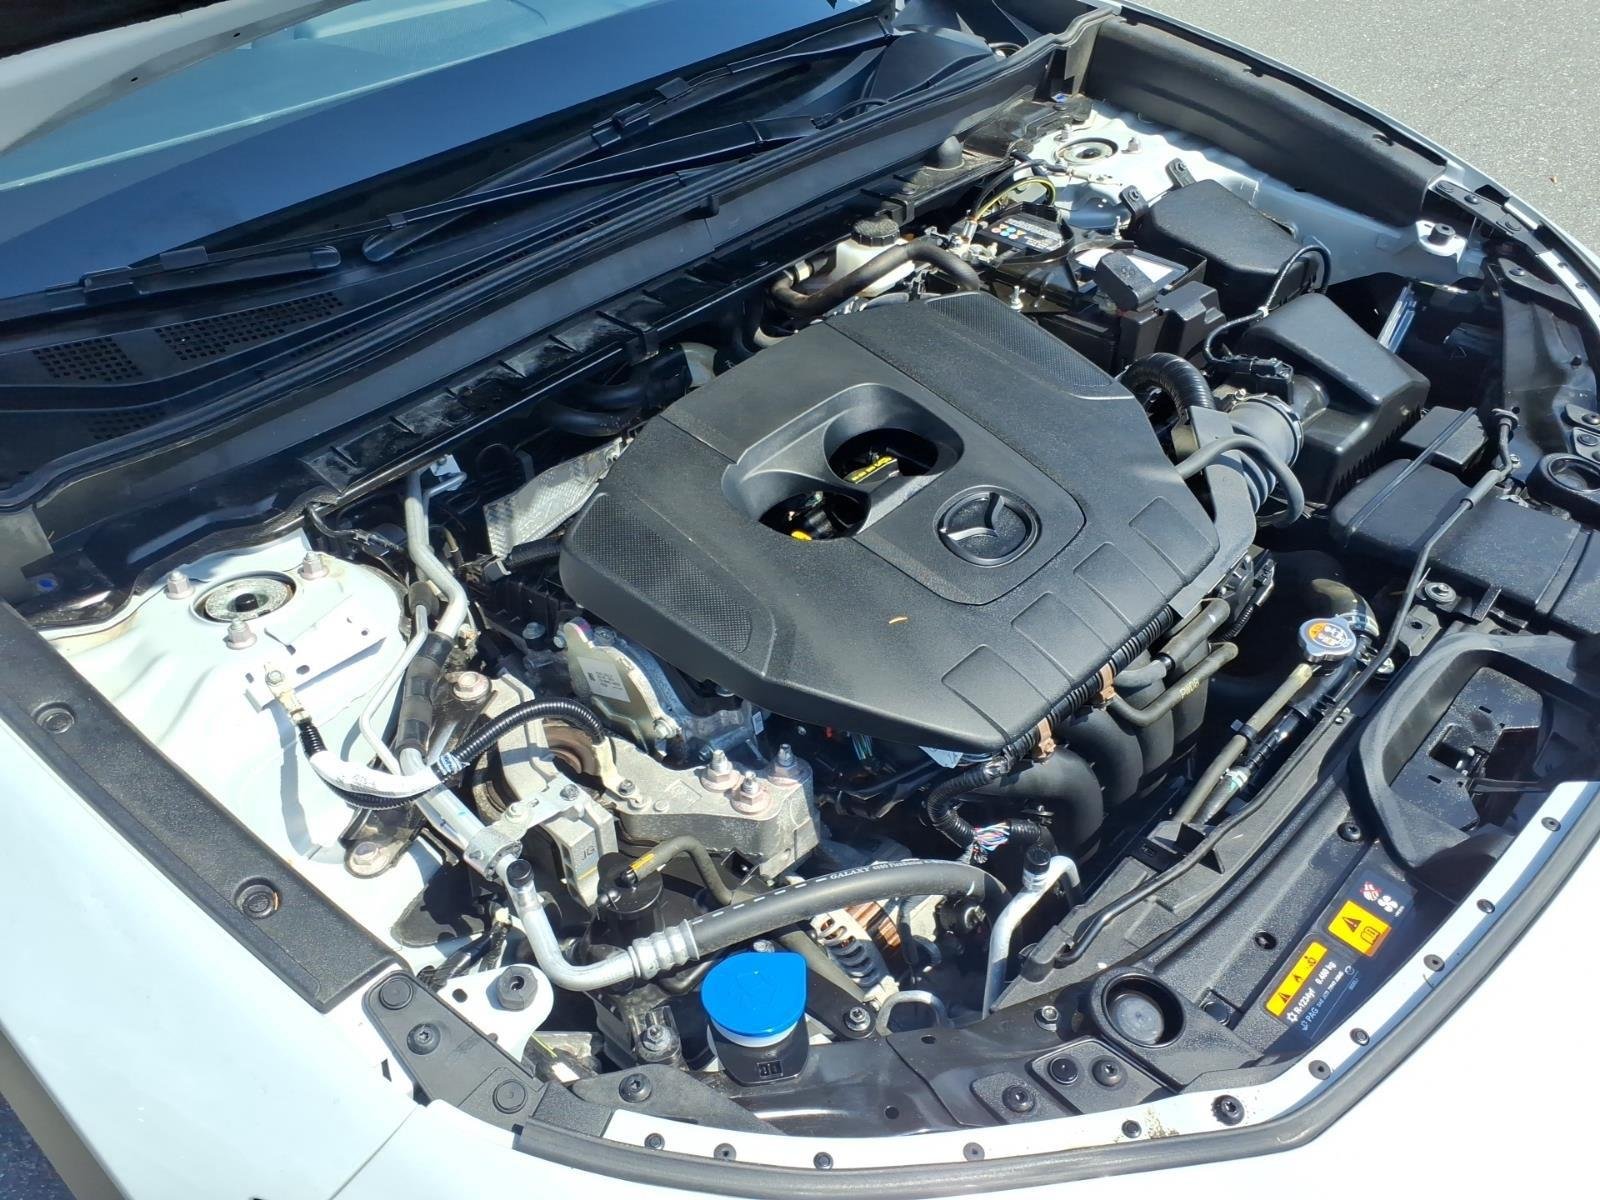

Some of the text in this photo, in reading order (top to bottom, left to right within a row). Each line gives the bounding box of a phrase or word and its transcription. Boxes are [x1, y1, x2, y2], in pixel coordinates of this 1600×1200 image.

[830, 866, 869, 880] GALAXY
[1293, 987, 1315, 1014] R-1234yf
[1305, 1007, 1319, 1023] PAG
